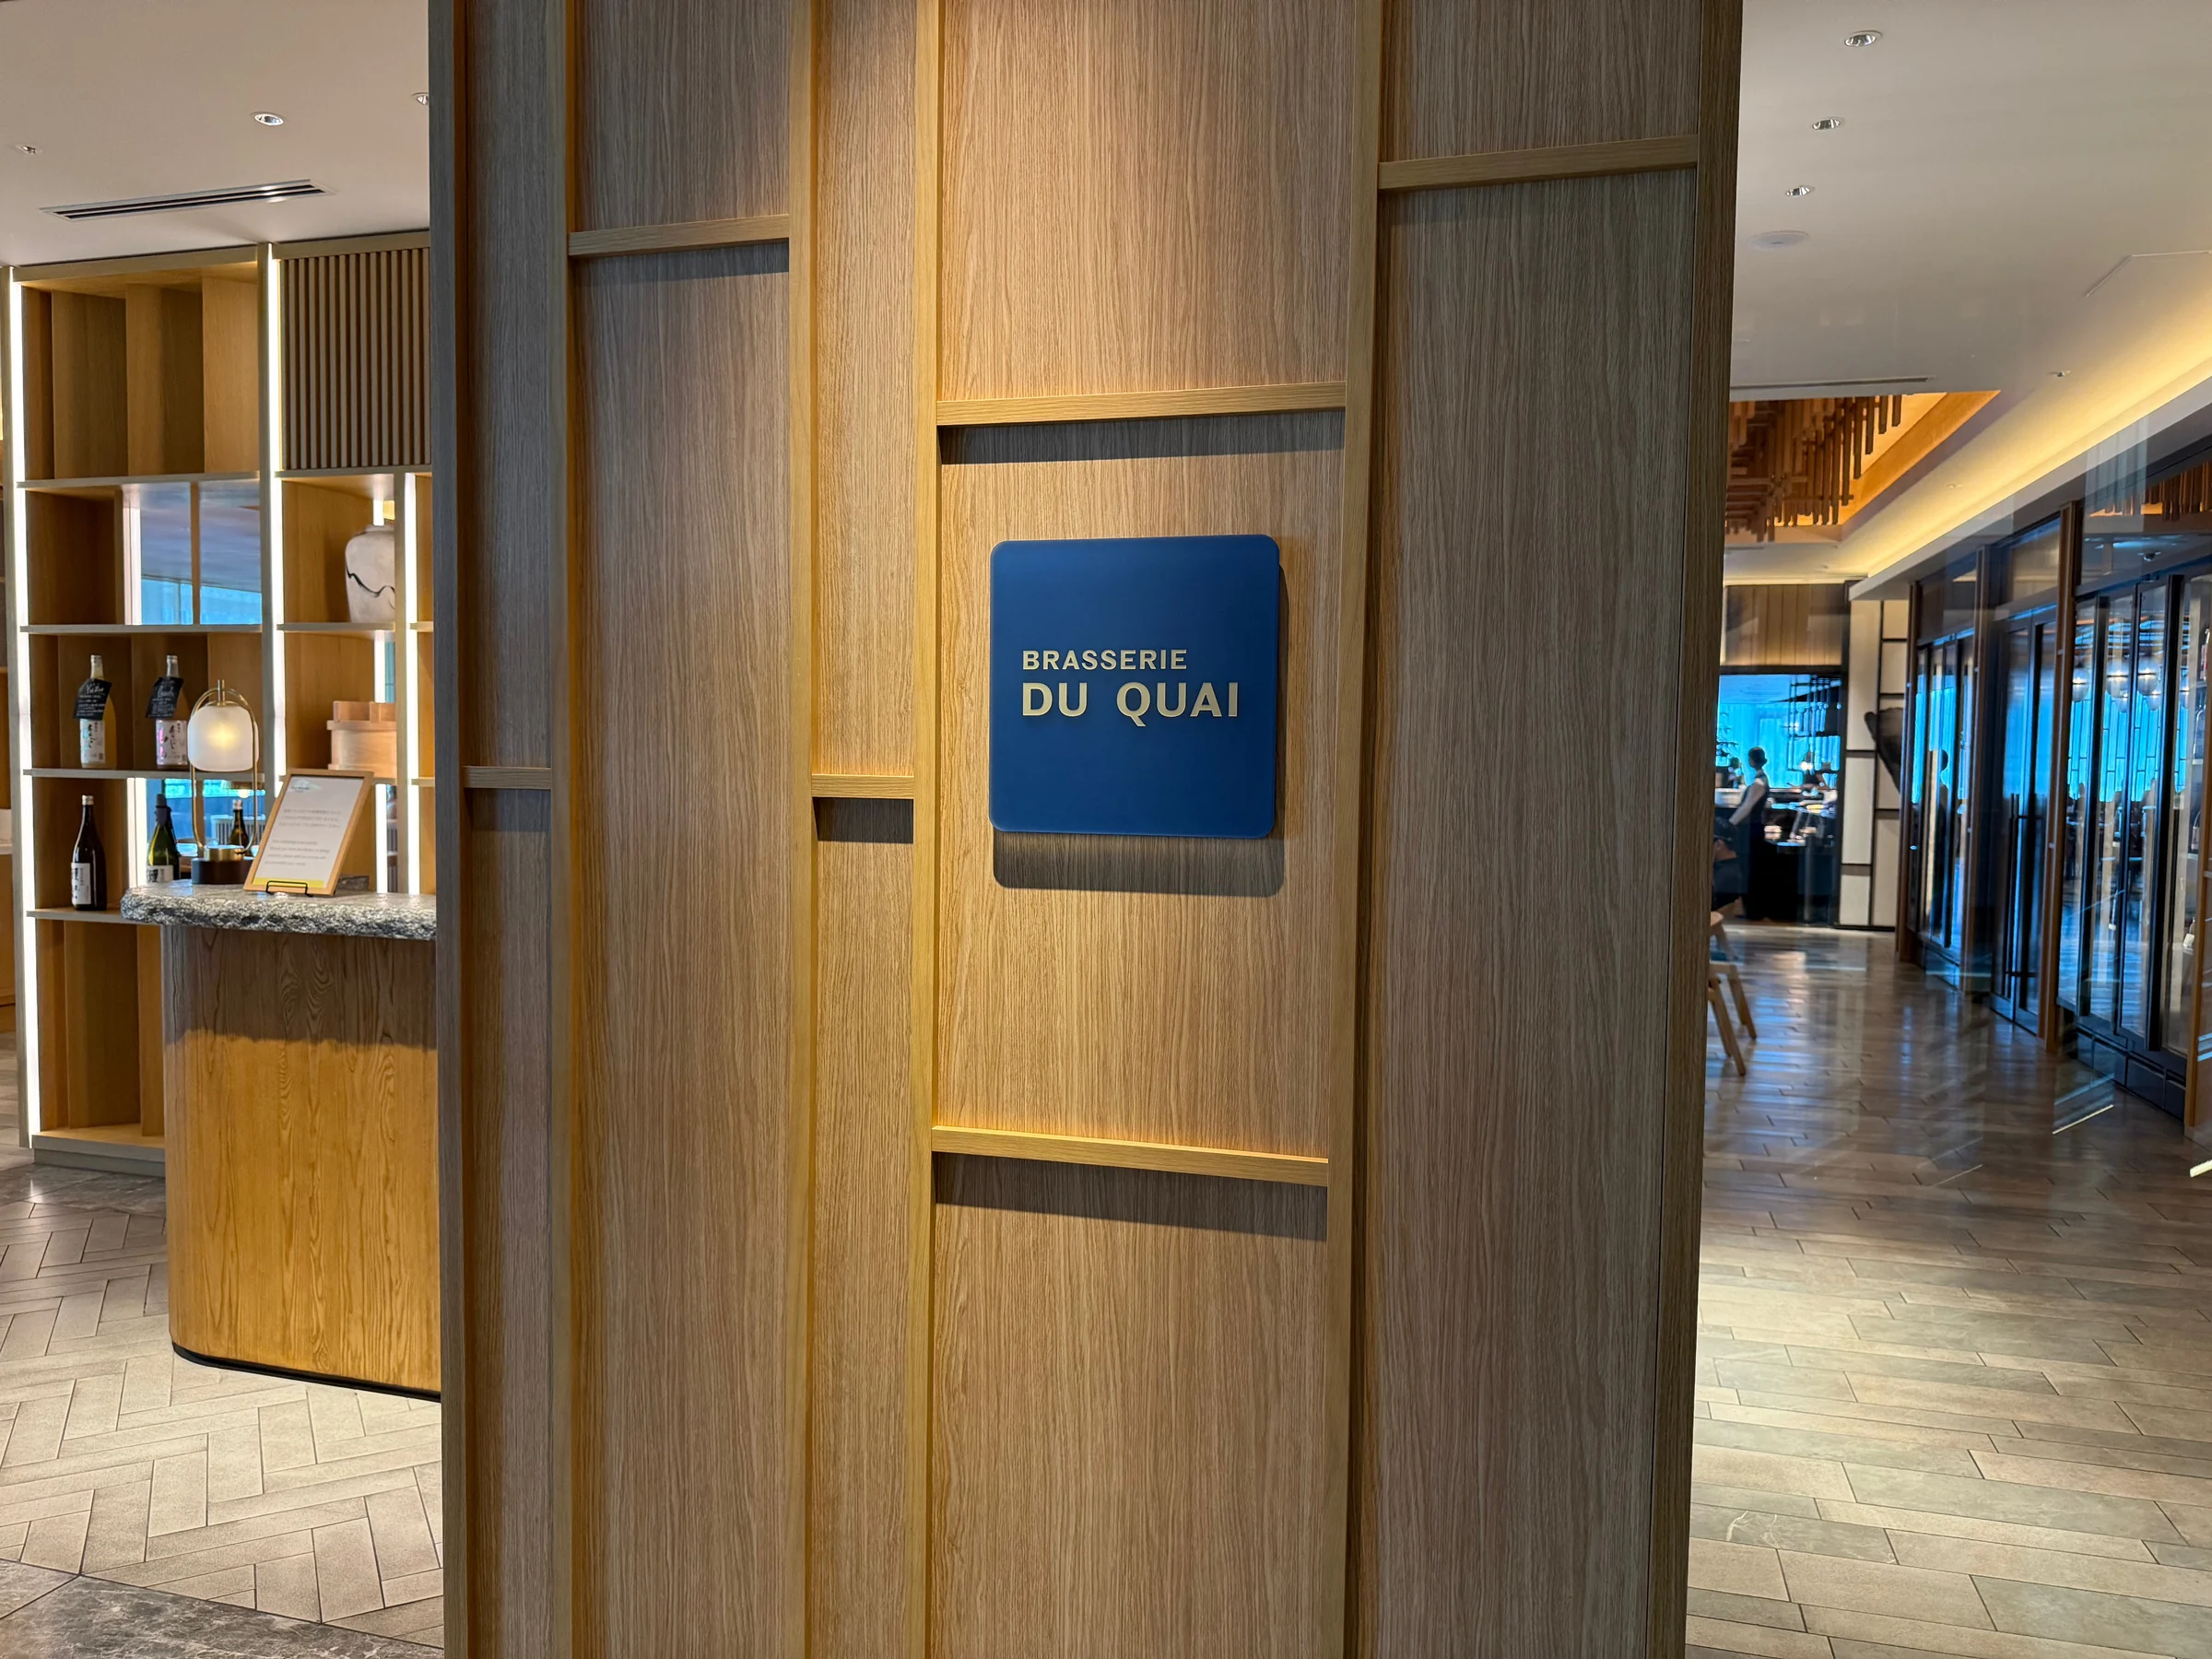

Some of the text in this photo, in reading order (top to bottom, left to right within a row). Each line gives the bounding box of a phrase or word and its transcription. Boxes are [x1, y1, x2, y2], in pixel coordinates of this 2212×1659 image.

[1022, 649, 1187, 670] BRASSERIE
[1022, 682, 1238, 726] DU QUAI
